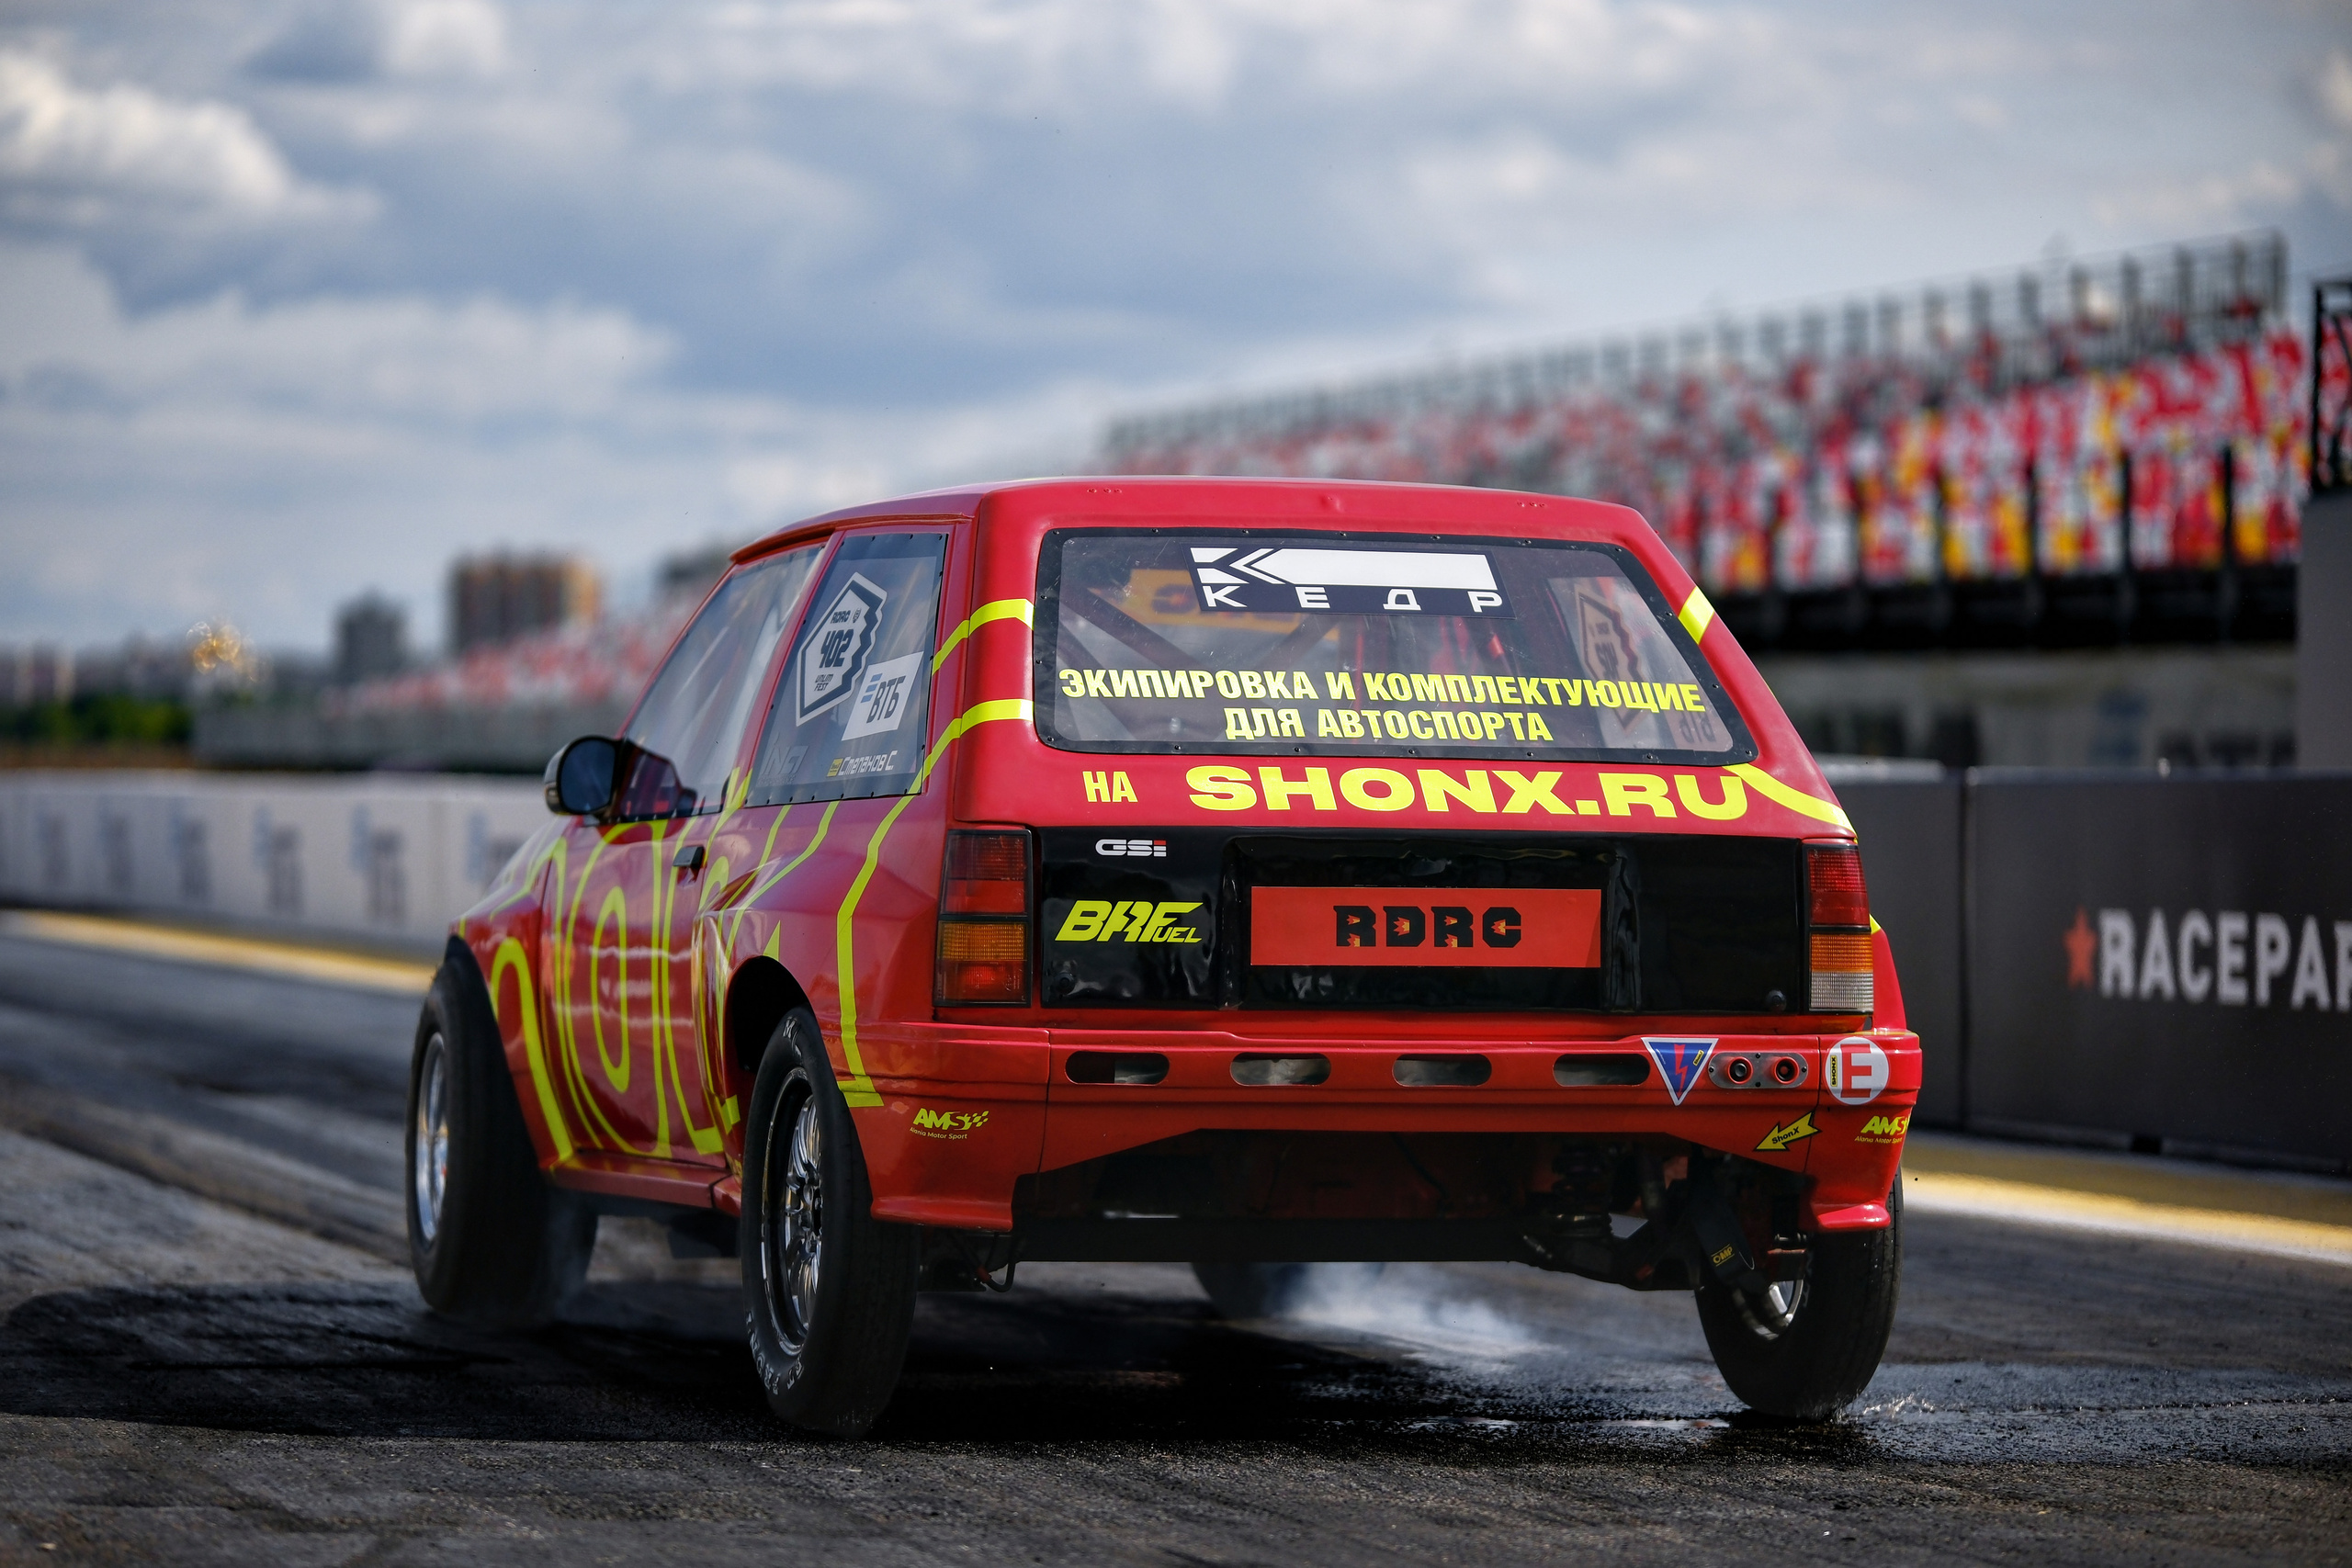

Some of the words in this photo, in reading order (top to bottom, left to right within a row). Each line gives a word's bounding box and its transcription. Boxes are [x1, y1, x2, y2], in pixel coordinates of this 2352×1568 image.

[1202, 585, 1503, 613] КЕДР
[820, 629, 854, 668] 402
[866, 675, 907, 724] ВТБ
[1060, 669, 1314, 700] ЭКИПИРОВКА
[1327, 671, 1354, 701] И
[1363, 673, 1706, 713] КОМПЛЕКТУЮЩИЕ
[1225, 707, 1306, 739] ДЛЯ
[1317, 708, 1554, 741] АВТОСПОРТА
[1082, 771, 1138, 803] НА
[1185, 765, 1748, 820] SHONX.RU
[1333, 905, 1521, 948] RDRC
[1840, 1043, 1872, 1098] E
[910, 1126, 927, 1136] Alania
[927, 1131, 947, 1139] Motor
[1771, 1126, 1800, 1145] ShonX
[1713, 1246, 1733, 1264] OMP
